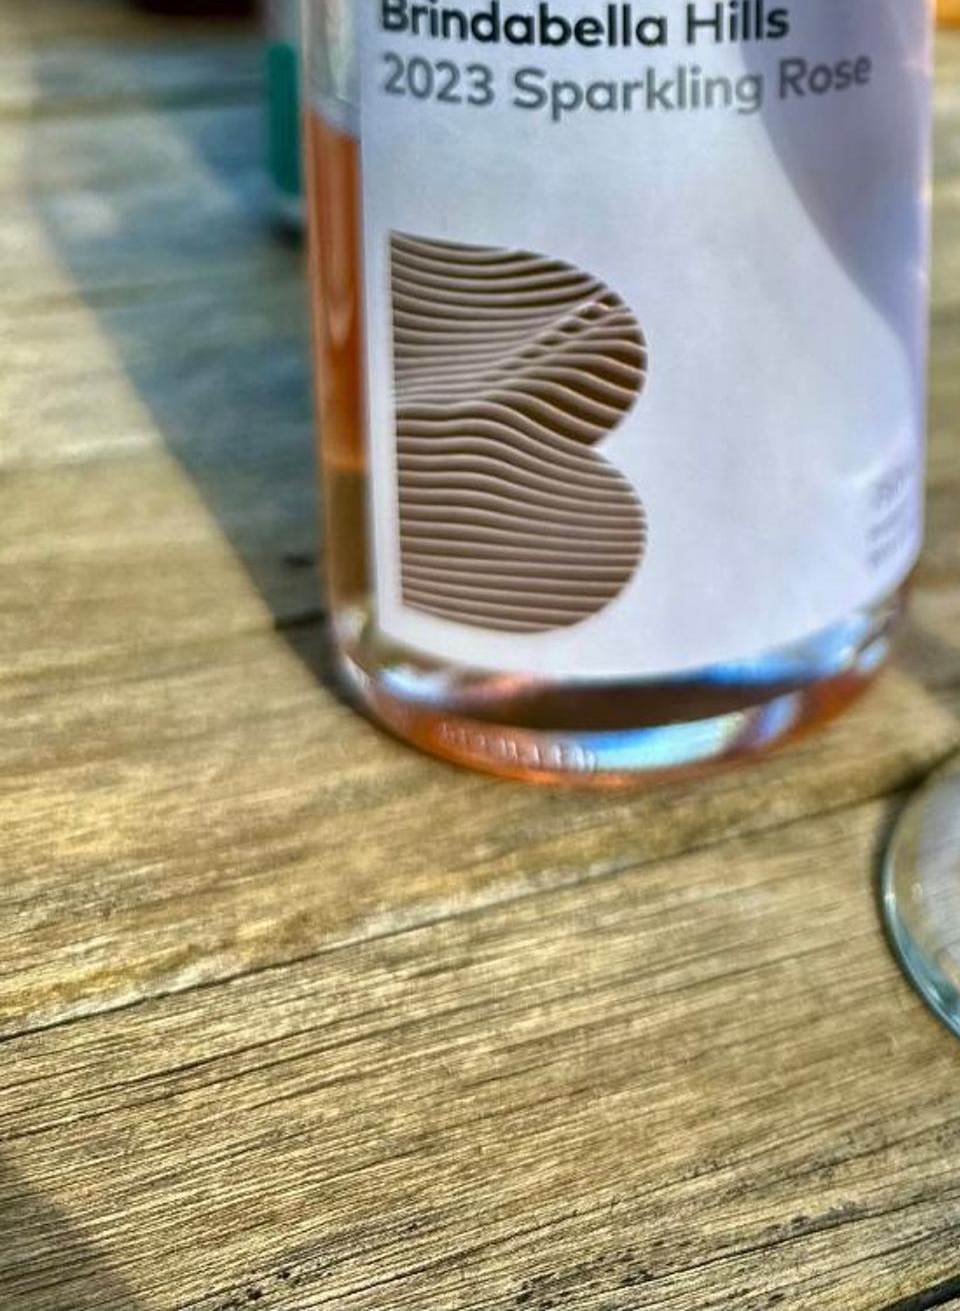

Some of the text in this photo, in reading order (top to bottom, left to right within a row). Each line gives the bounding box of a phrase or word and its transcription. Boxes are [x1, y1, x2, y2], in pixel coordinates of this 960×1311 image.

[382, 53, 872, 121] 2023 Sparkling Rose
